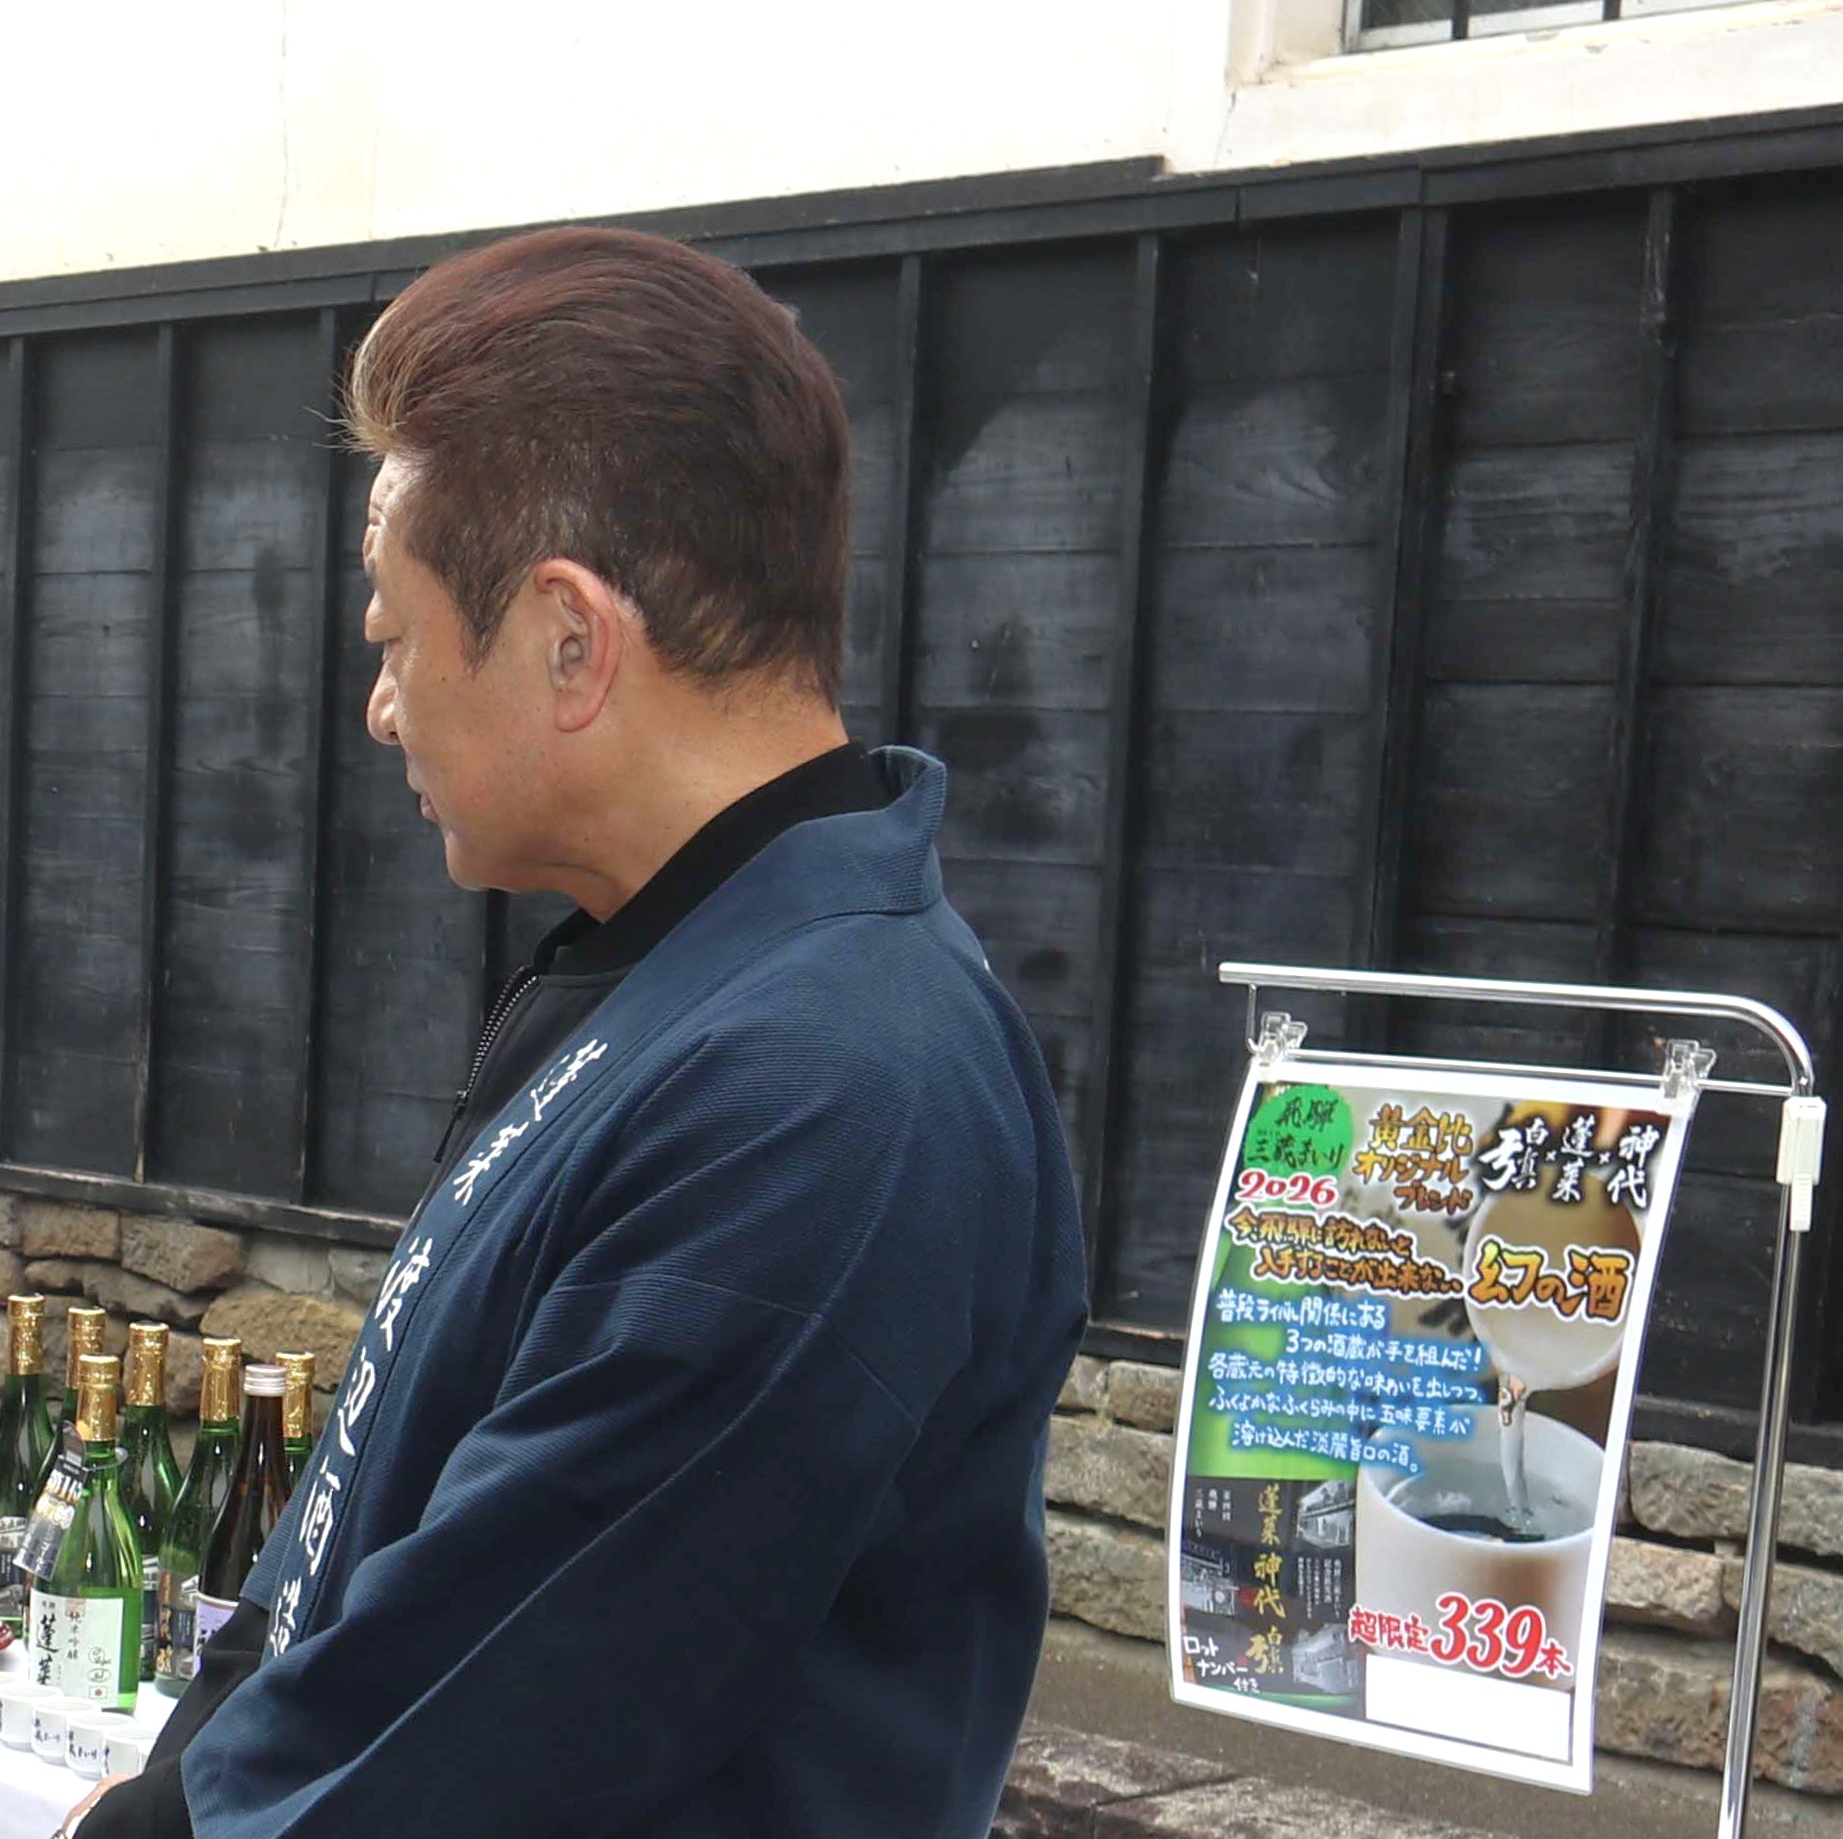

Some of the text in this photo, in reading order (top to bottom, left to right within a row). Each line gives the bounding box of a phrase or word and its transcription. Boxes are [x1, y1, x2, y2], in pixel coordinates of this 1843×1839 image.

[1369, 1103, 1474, 1155] 黄金比
[1353, 1150, 1469, 1185] オリジナル
[1606, 1124, 1661, 1208] 神代
[1236, 1170, 1337, 1205] 2026
[1392, 1181, 1474, 1214] ブレンド
[1467, 1238, 1631, 1322] 幻の酒
[1253, 1552, 1286, 1619] 神代
[1183, 1635, 1219, 1657] ロット
[1196, 1660, 1249, 1678] ナンバー
